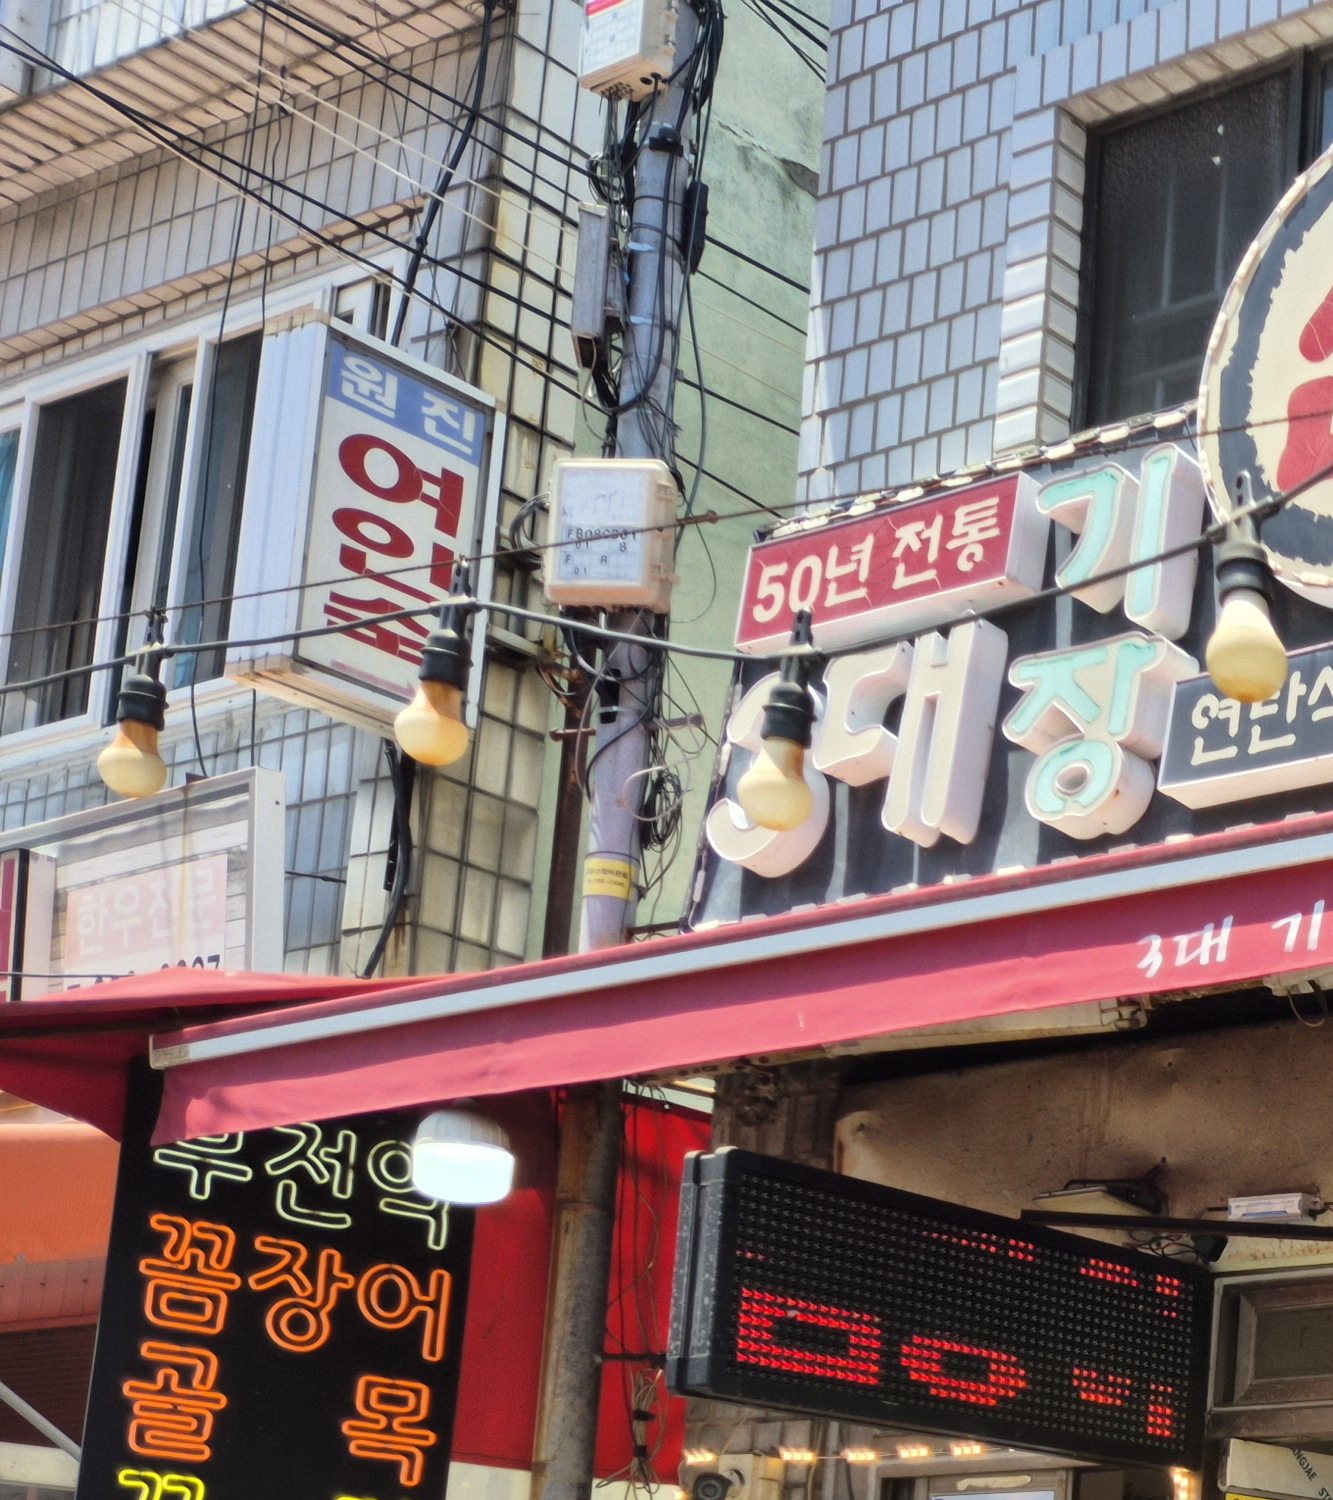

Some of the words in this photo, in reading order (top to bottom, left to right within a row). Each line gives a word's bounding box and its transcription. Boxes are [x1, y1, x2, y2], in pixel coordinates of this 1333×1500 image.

[341, 355, 478, 456] 원진
[753, 532, 875, 625] 50년
[892, 496, 1000, 590] 전통
[1002, 441, 1201, 840] 기장
[1136, 915, 1234, 979] 3대
[138, 1212, 453, 1362] 꼼장어
